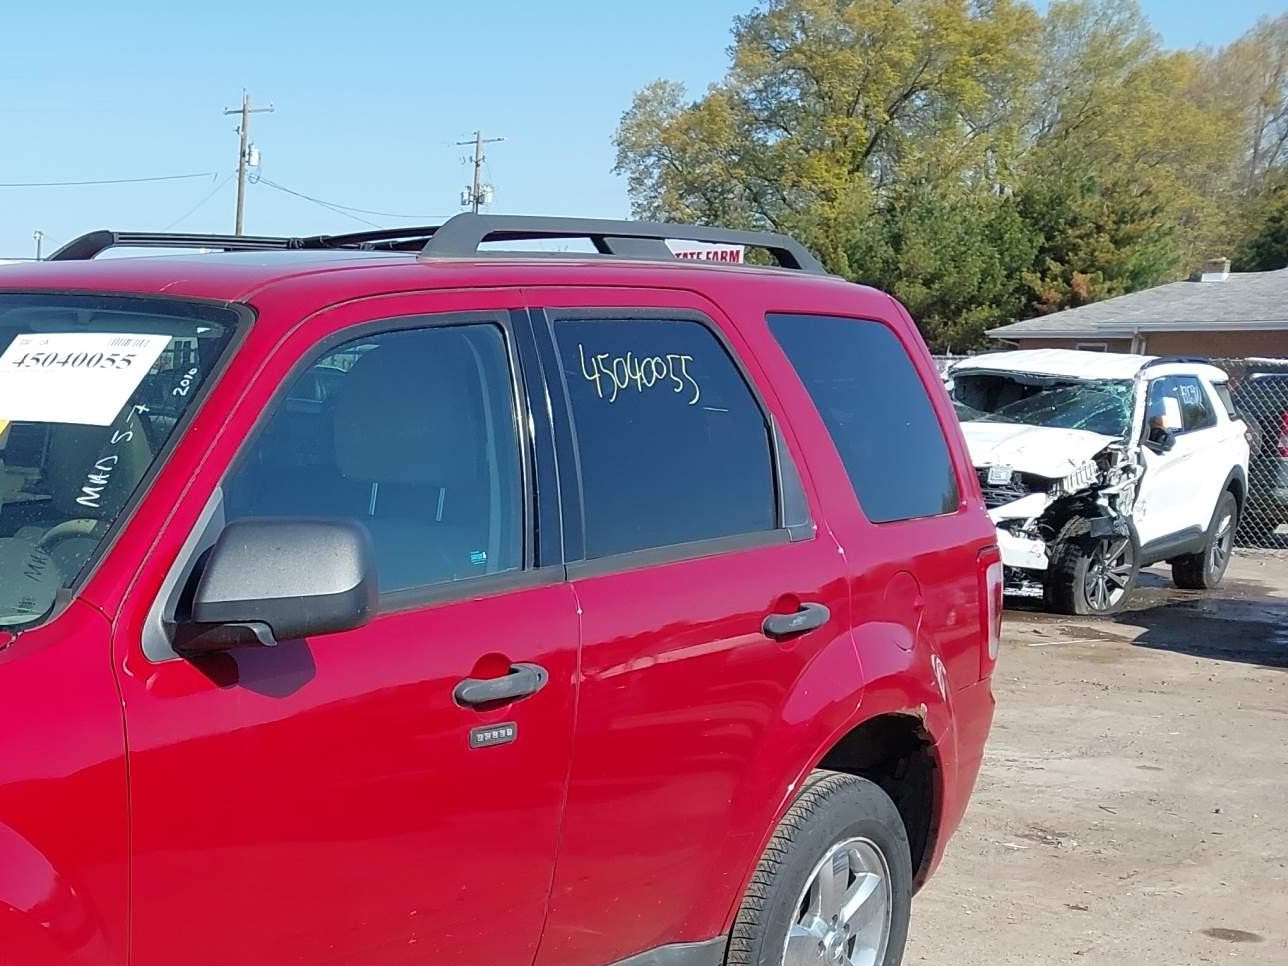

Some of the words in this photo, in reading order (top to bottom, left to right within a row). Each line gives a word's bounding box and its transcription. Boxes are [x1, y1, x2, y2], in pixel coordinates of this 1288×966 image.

[12, 352, 137, 370] 45040055
[578, 343, 700, 405] 45040055
[172, 367, 198, 396] 2010
